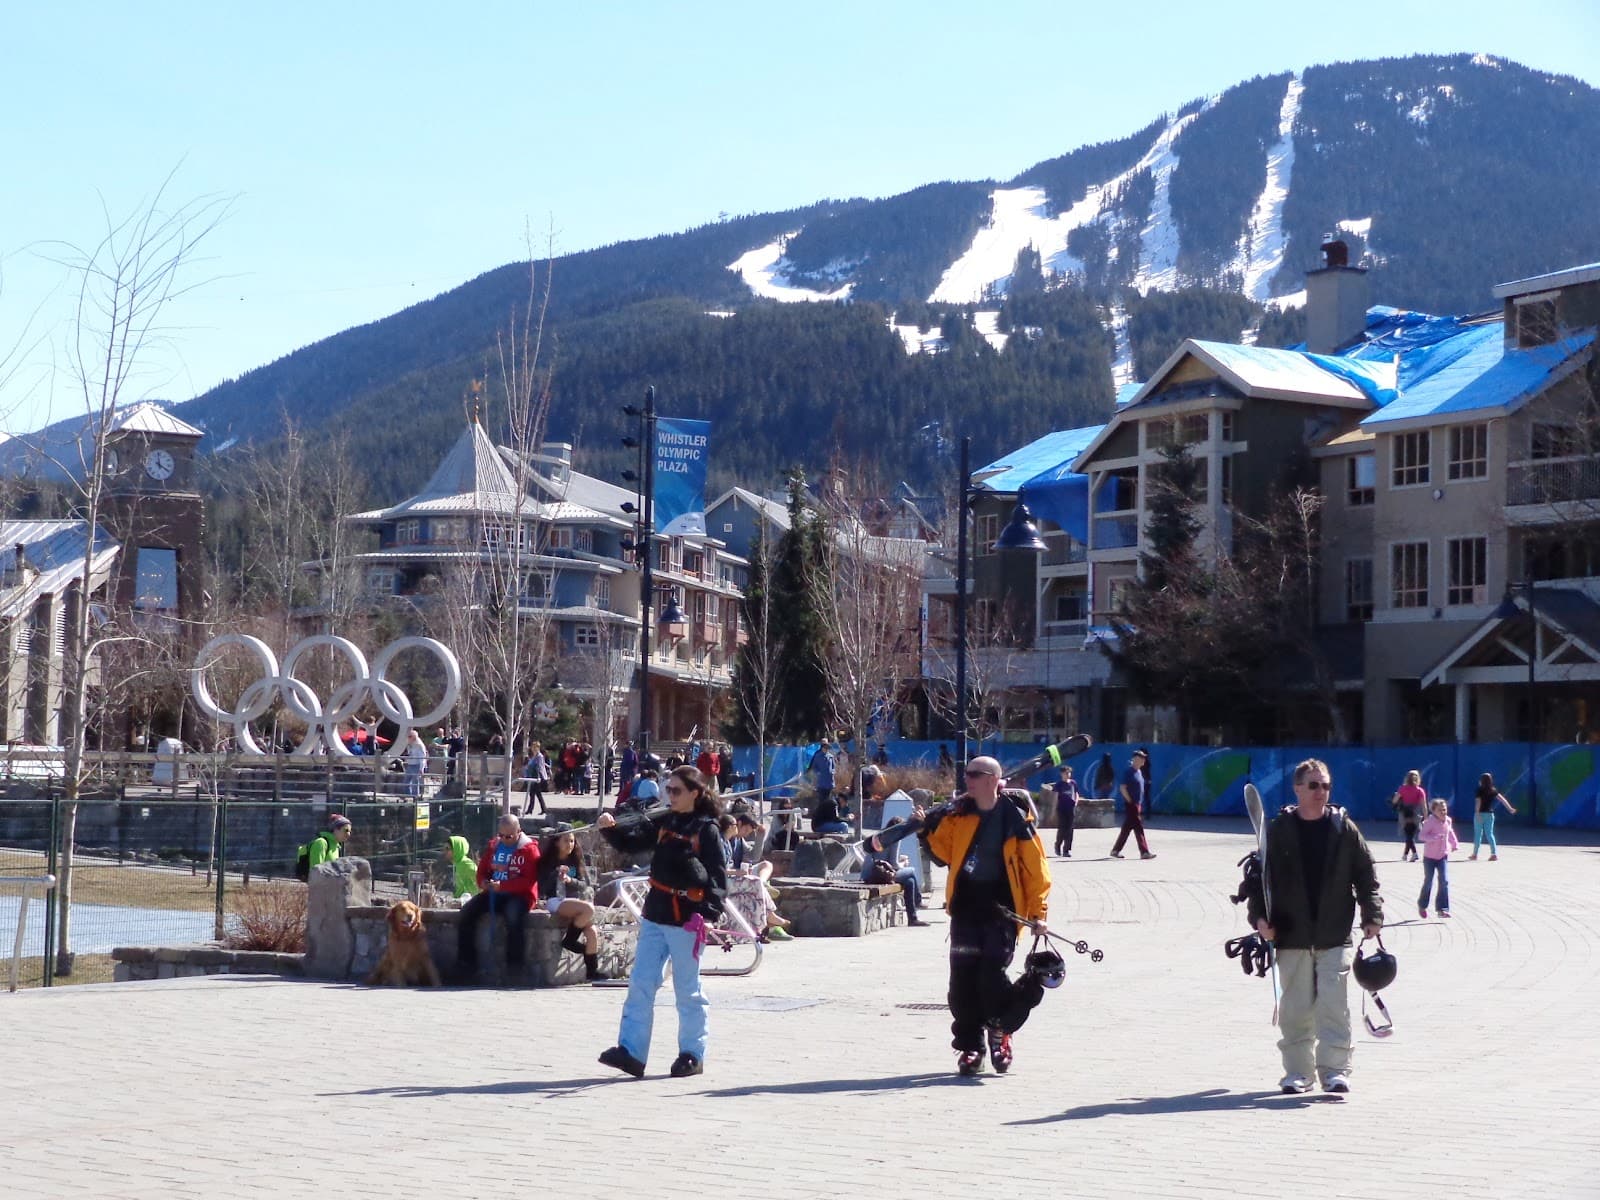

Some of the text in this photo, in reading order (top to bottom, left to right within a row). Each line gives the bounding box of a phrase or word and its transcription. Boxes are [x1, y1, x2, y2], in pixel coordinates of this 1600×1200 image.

[658, 431, 707, 447] WHISTLER
[657, 446, 701, 461] OLYMPIC
[657, 460, 689, 473] PLAZA
